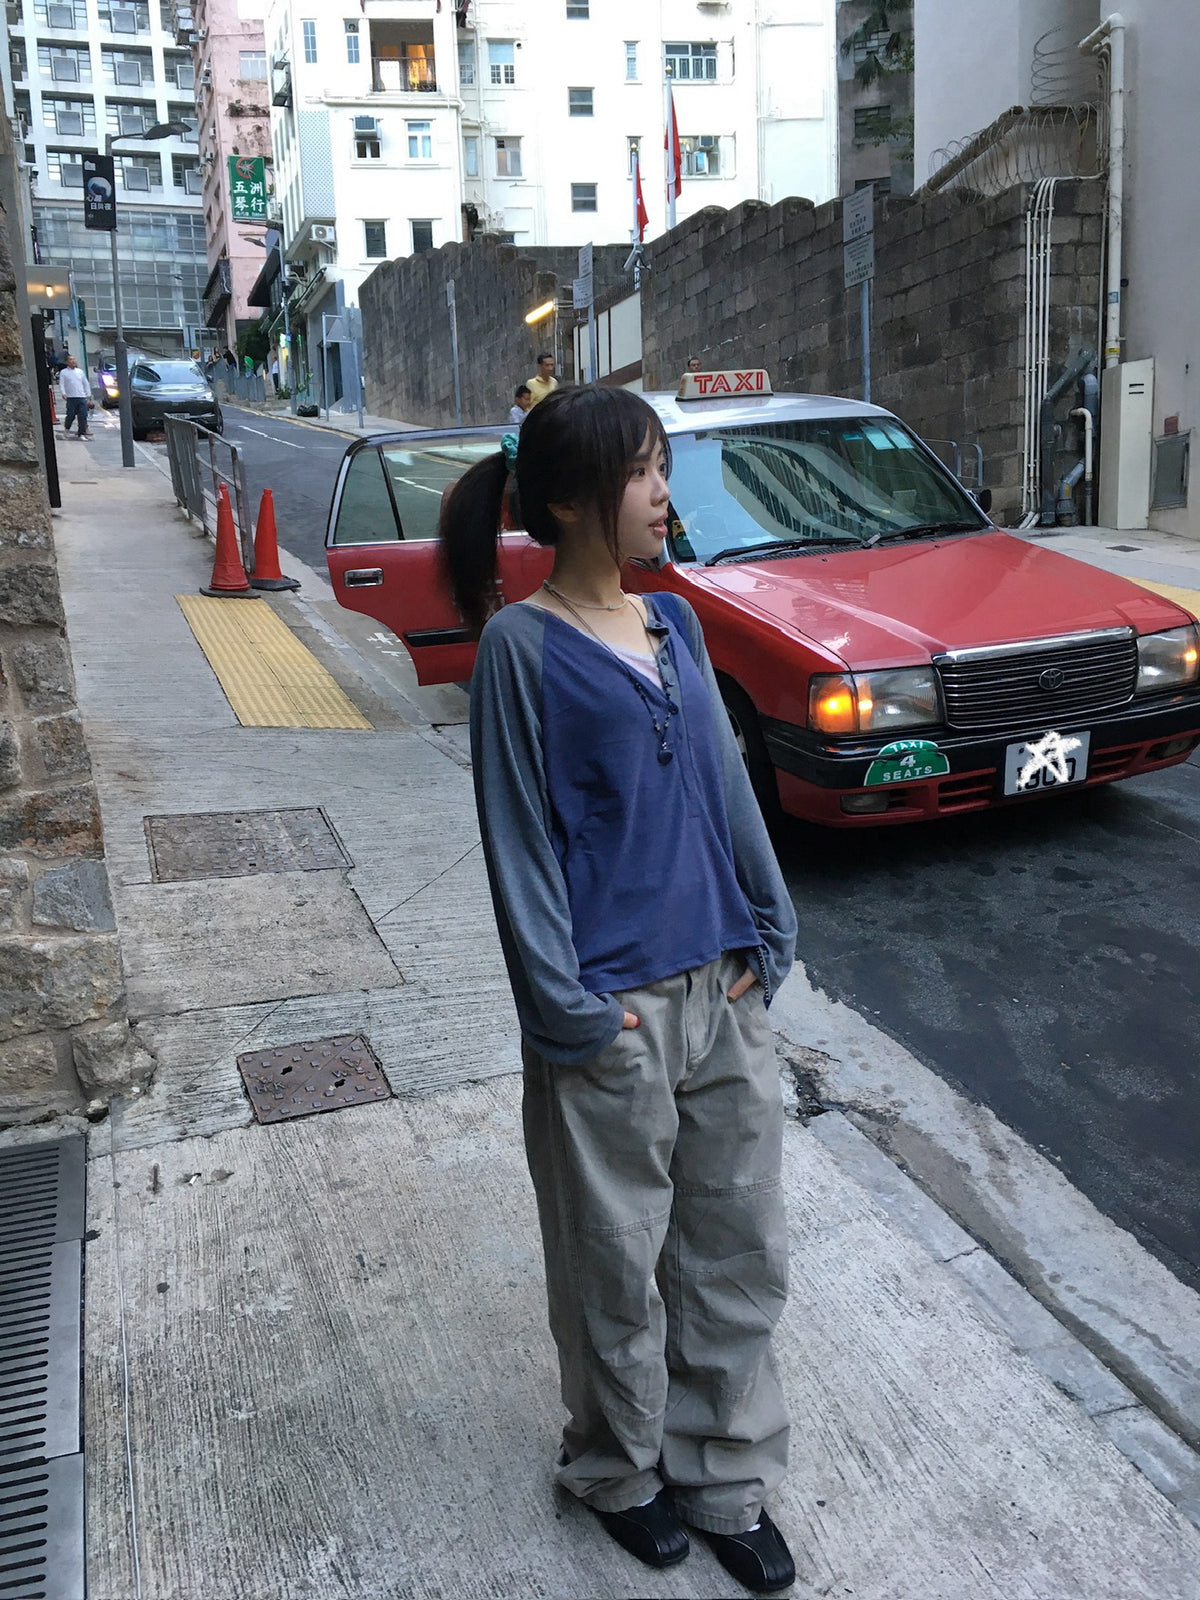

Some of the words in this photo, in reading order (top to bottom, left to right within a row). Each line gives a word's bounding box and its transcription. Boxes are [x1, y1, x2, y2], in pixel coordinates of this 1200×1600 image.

[233, 181, 263, 196] 五洲
[234, 196, 265, 212] 琴行
[694, 371, 764, 394] TAXI
[889, 741, 924, 753] TAXI
[900, 754, 917, 768] 4
[882, 765, 933, 781] SEATS
